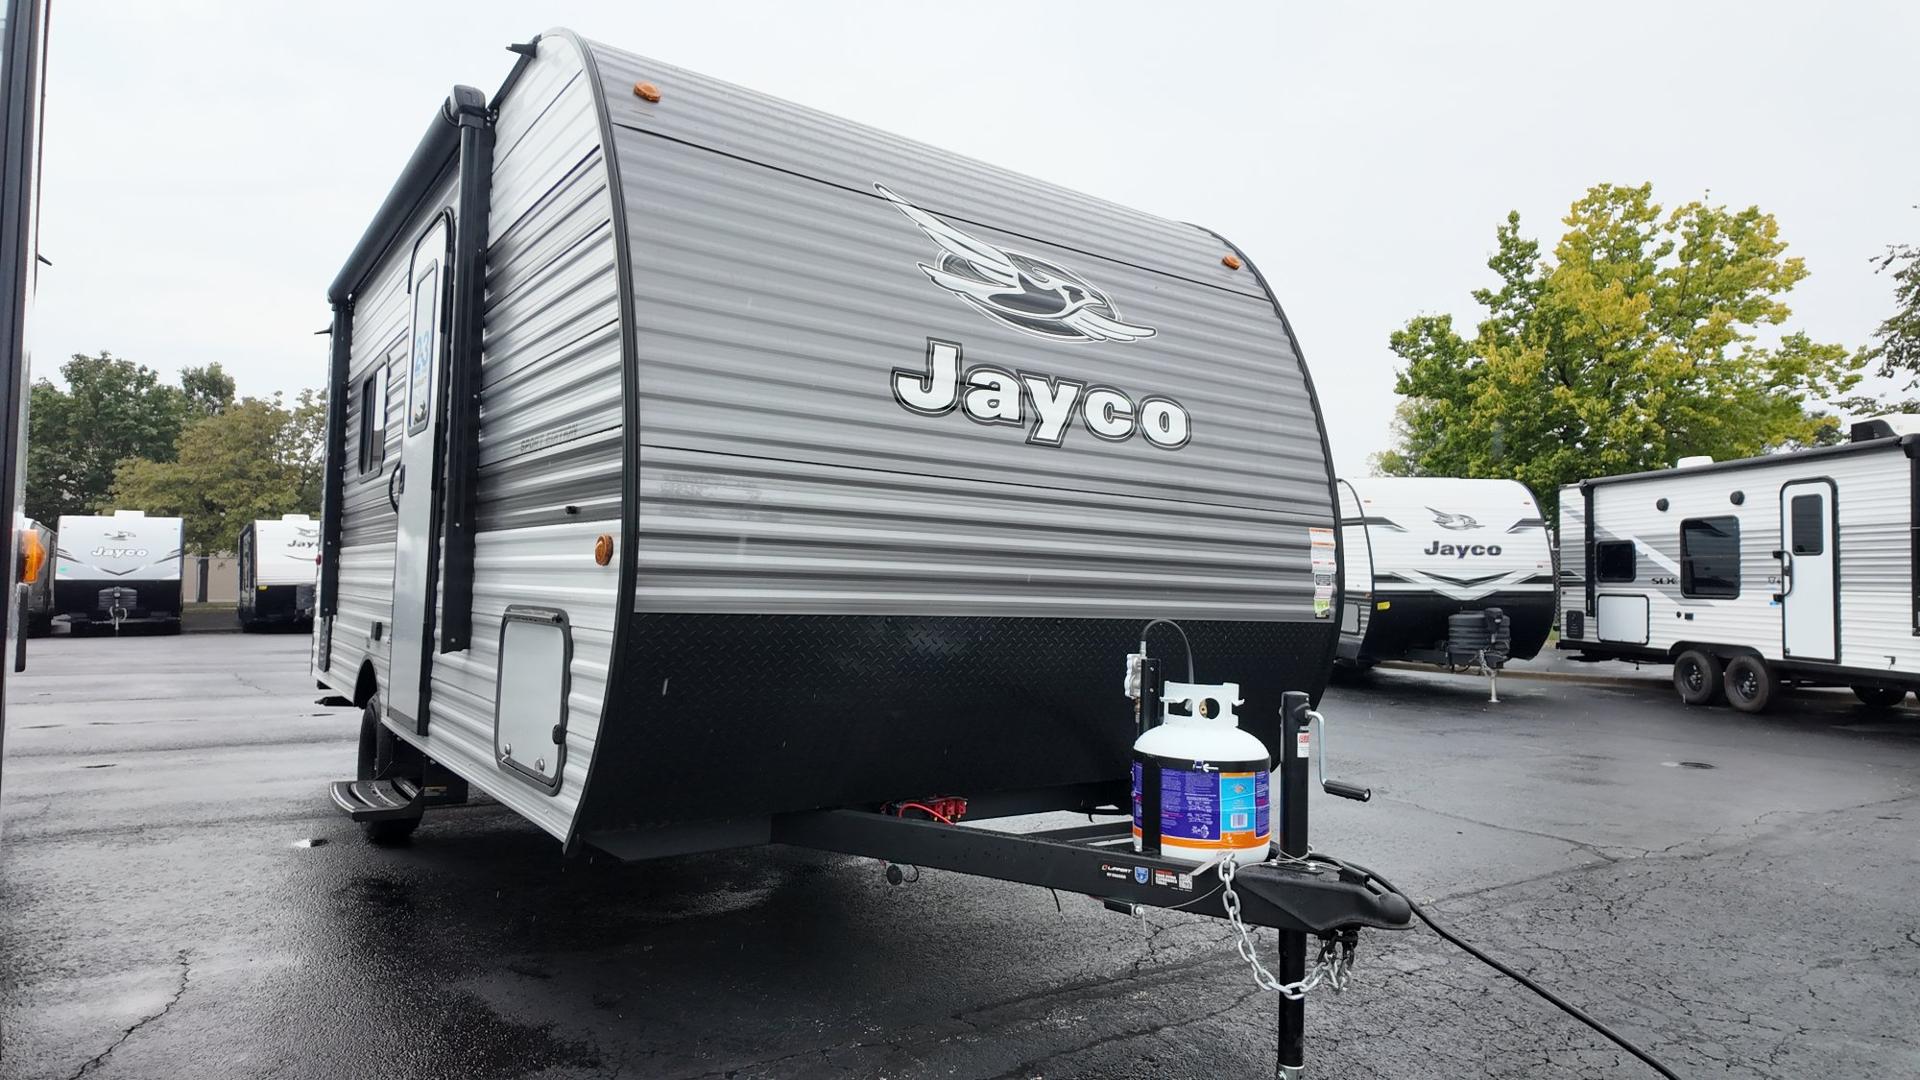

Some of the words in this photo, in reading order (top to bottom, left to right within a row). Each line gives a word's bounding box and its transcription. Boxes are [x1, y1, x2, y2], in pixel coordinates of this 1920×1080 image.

[889, 336, 1192, 449] Jayco
[91, 547, 149, 558] Jayco
[1424, 541, 1502, 559] Jayco
